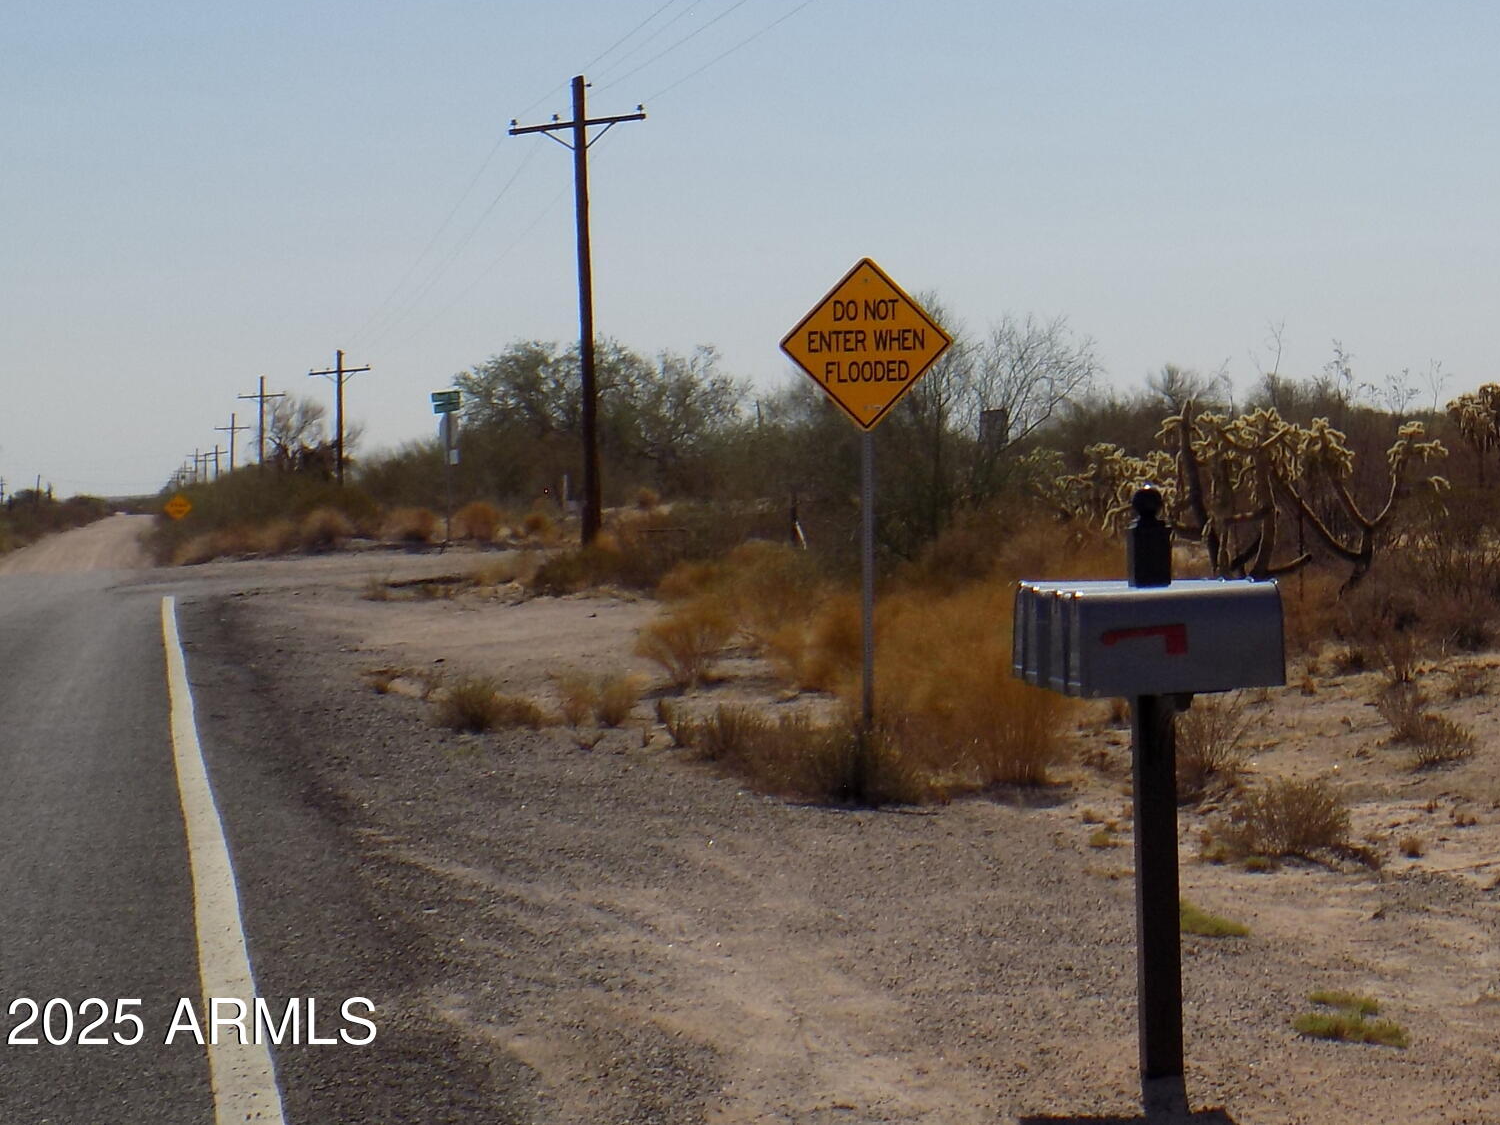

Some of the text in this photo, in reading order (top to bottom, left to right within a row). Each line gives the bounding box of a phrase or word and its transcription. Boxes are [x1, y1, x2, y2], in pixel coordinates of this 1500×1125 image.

[833, 299, 899, 322] DO NOT
[808, 329, 925, 354] ENTER WHEN
[825, 360, 910, 383] FLOODED
